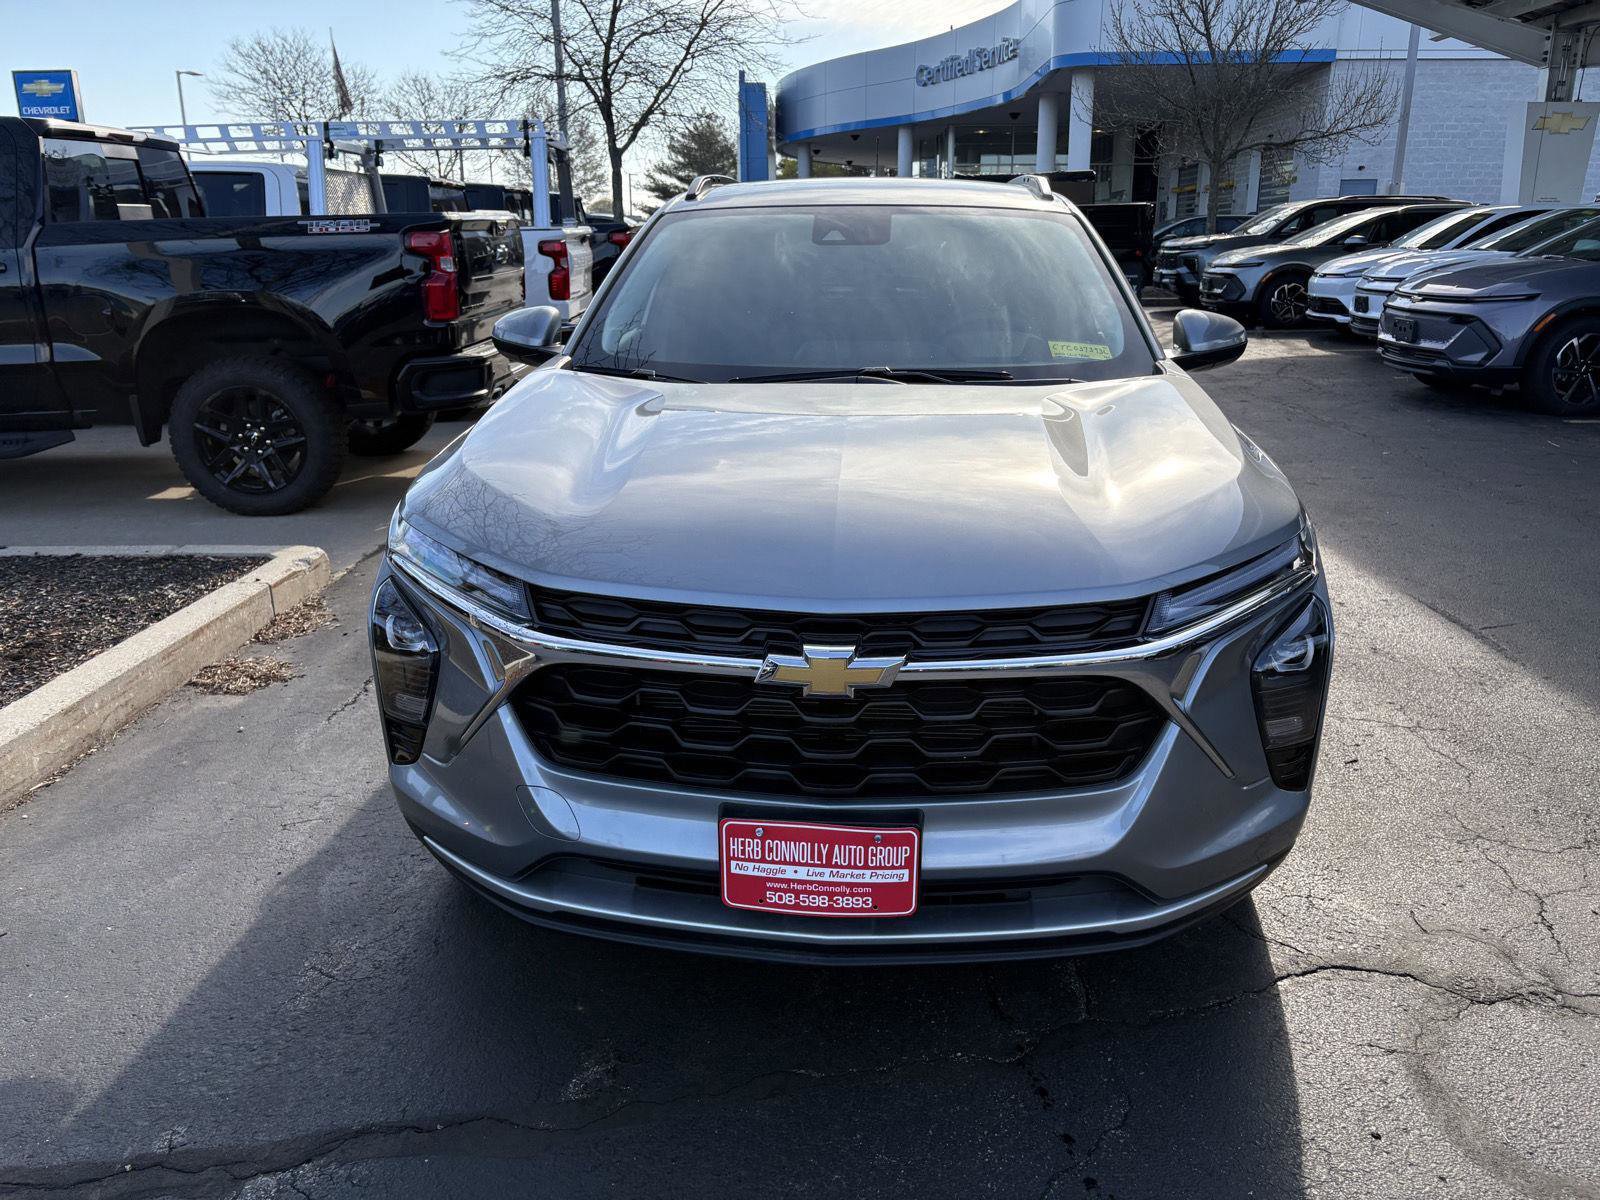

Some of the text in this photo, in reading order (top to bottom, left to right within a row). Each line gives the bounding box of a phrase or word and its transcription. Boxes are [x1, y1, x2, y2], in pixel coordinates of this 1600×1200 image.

[916, 37, 1020, 87] Certified Service
[22, 106, 70, 115] CHEVROLET
[730, 837, 910, 867] HERB CONNOLLY AUTO GROUP
[734, 862, 905, 881] No Haggle Live Market Pricing
[766, 881, 872, 894] www.HerbConnolly.com
[766, 891, 873, 908] 508-598-3893
